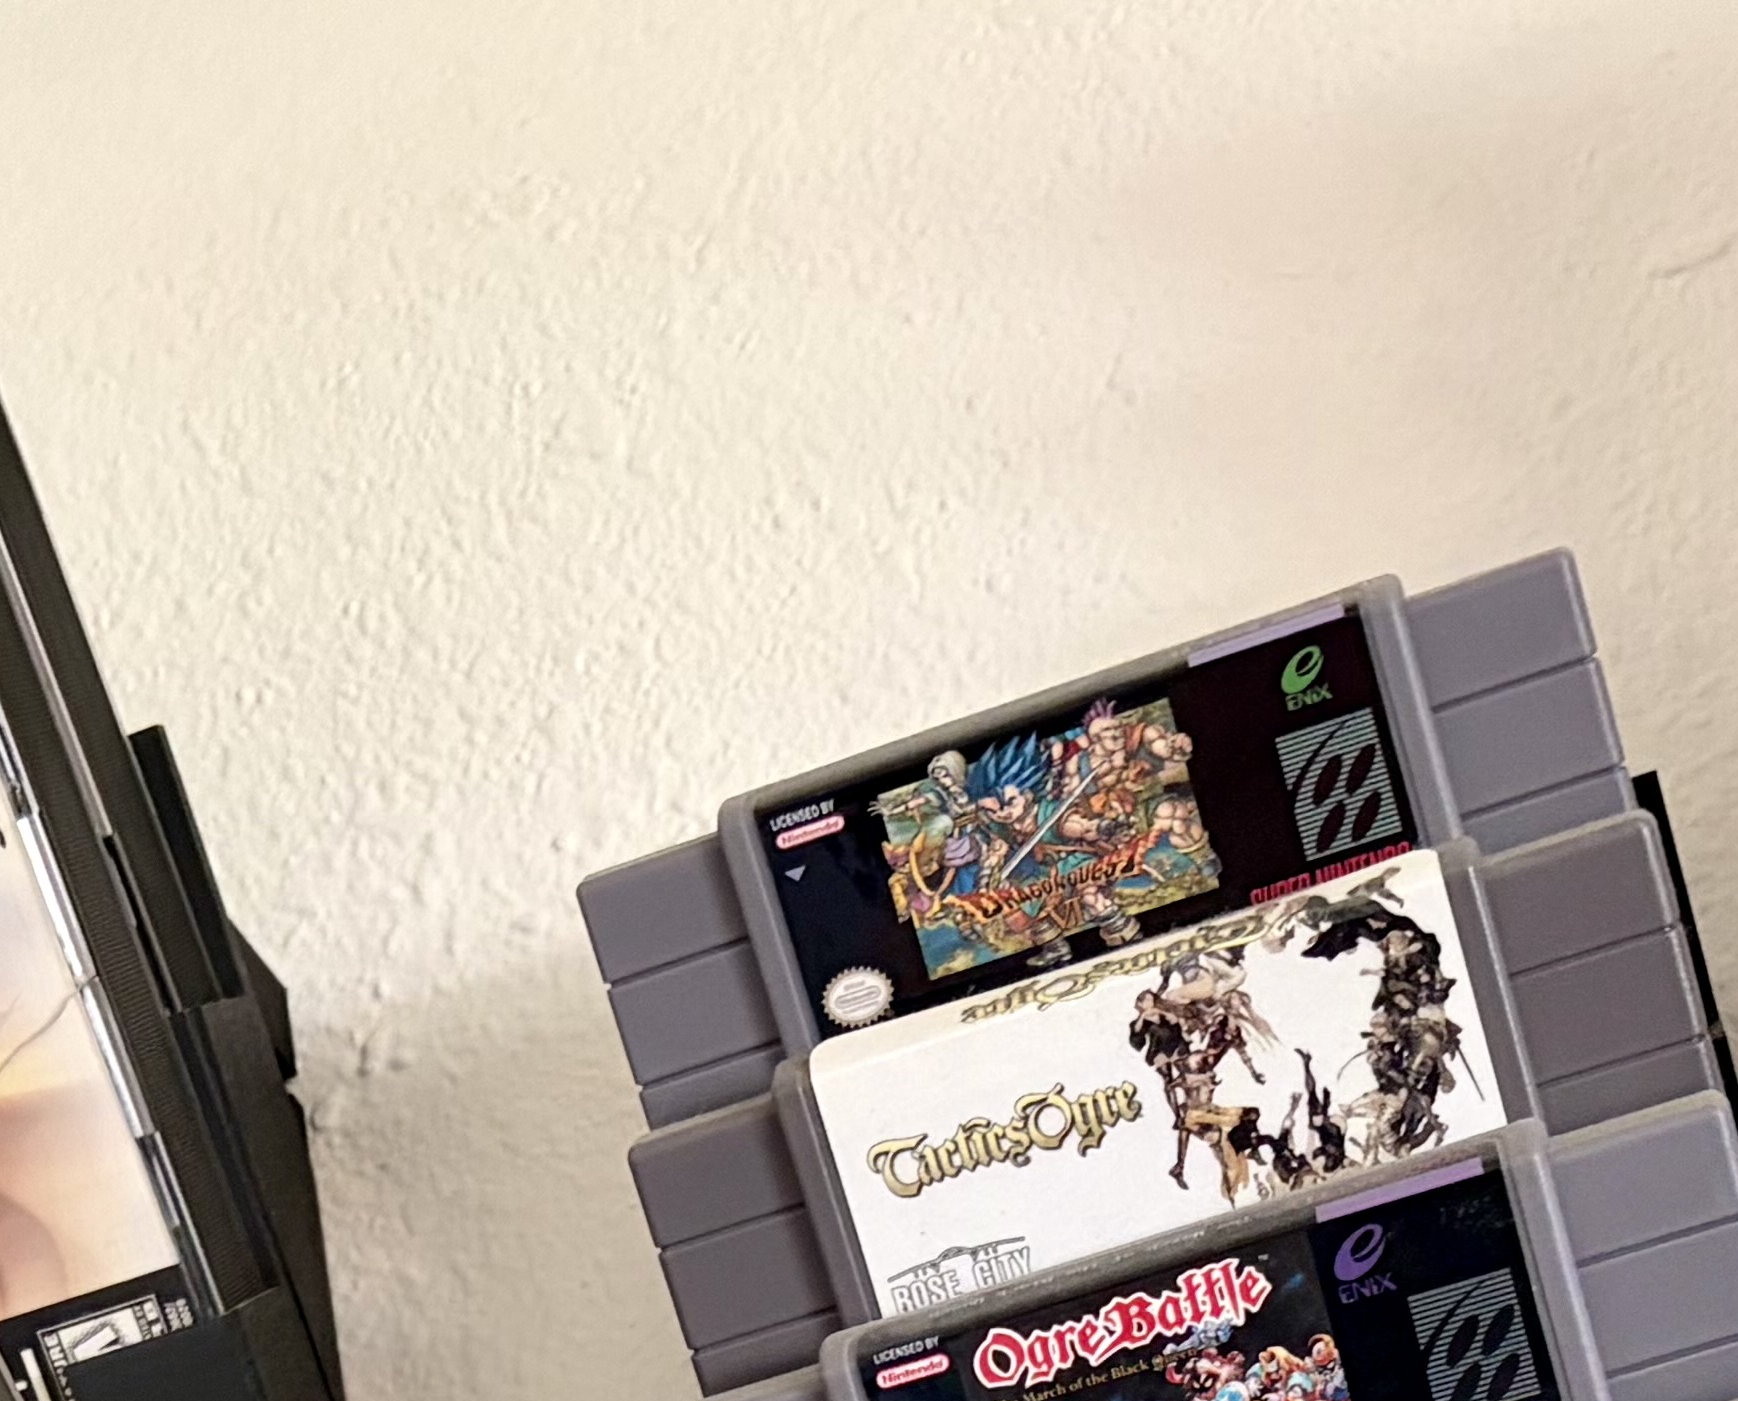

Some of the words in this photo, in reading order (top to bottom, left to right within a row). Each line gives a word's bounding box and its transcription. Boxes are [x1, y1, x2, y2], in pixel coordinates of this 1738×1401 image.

[1284, 682, 1333, 711] ENIX
[769, 803, 821, 832] LICENSED
[820, 799, 836, 816] BY
[780, 818, 844, 847] Nintendo
[891, 1268, 961, 1313] ROSE
[974, 1246, 1032, 1287] CITY
[1337, 1272, 1398, 1304] ENIX
[872, 1339, 921, 1366] LICENSED
[920, 1335, 940, 1352] BY
[880, 1357, 946, 1387] Nintendo
[1068, 1379, 1086, 1394] of
[1086, 1372, 1108, 1388] the
[1110, 1359, 1149, 1383] Black
